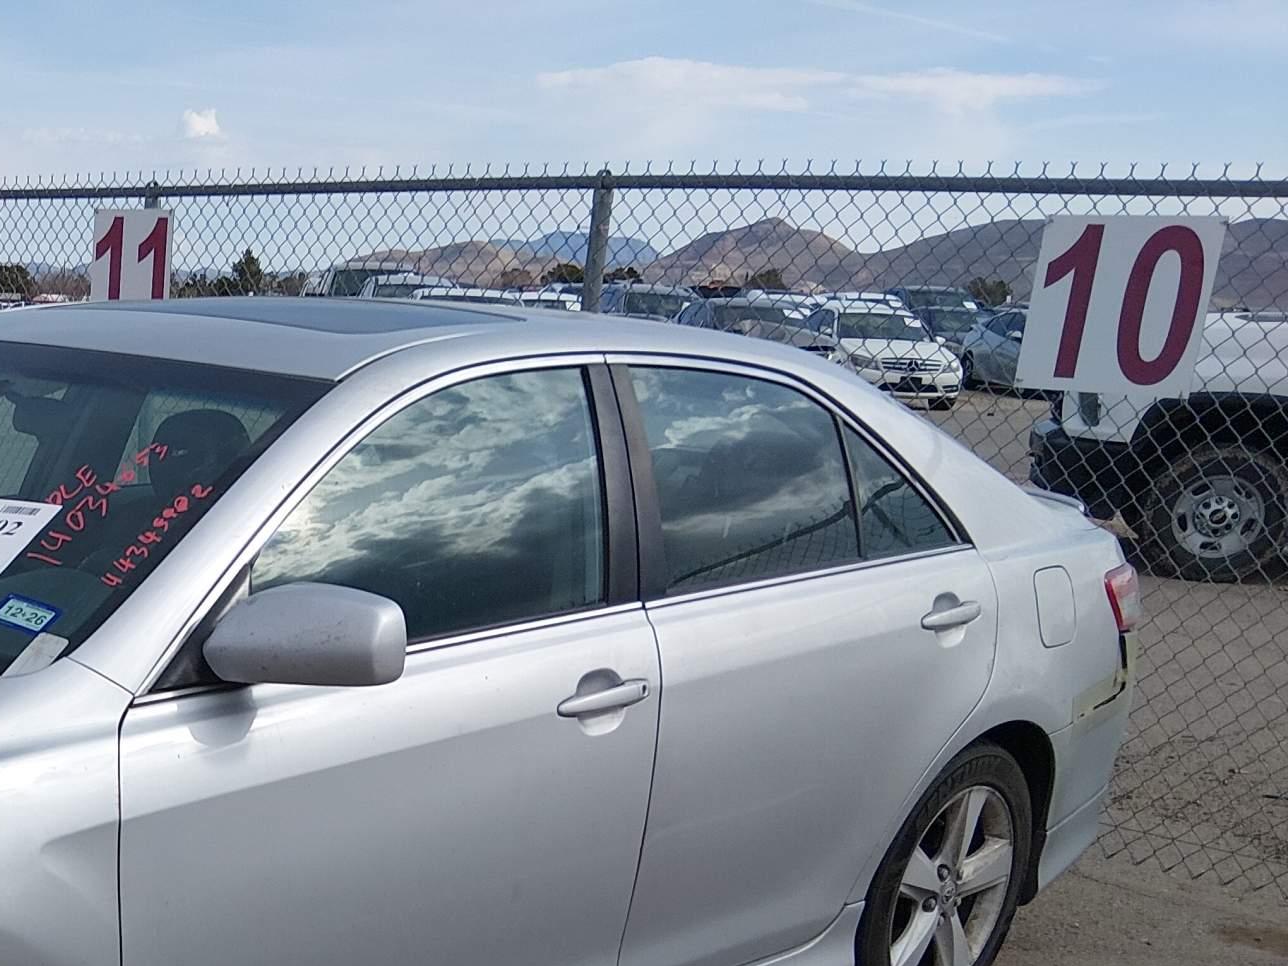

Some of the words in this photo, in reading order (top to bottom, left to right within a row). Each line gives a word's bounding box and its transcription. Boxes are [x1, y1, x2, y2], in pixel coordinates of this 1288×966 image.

[95, 216, 168, 300] 11
[1043, 224, 1205, 386] 10
[100, 484, 213, 586] 44345902
